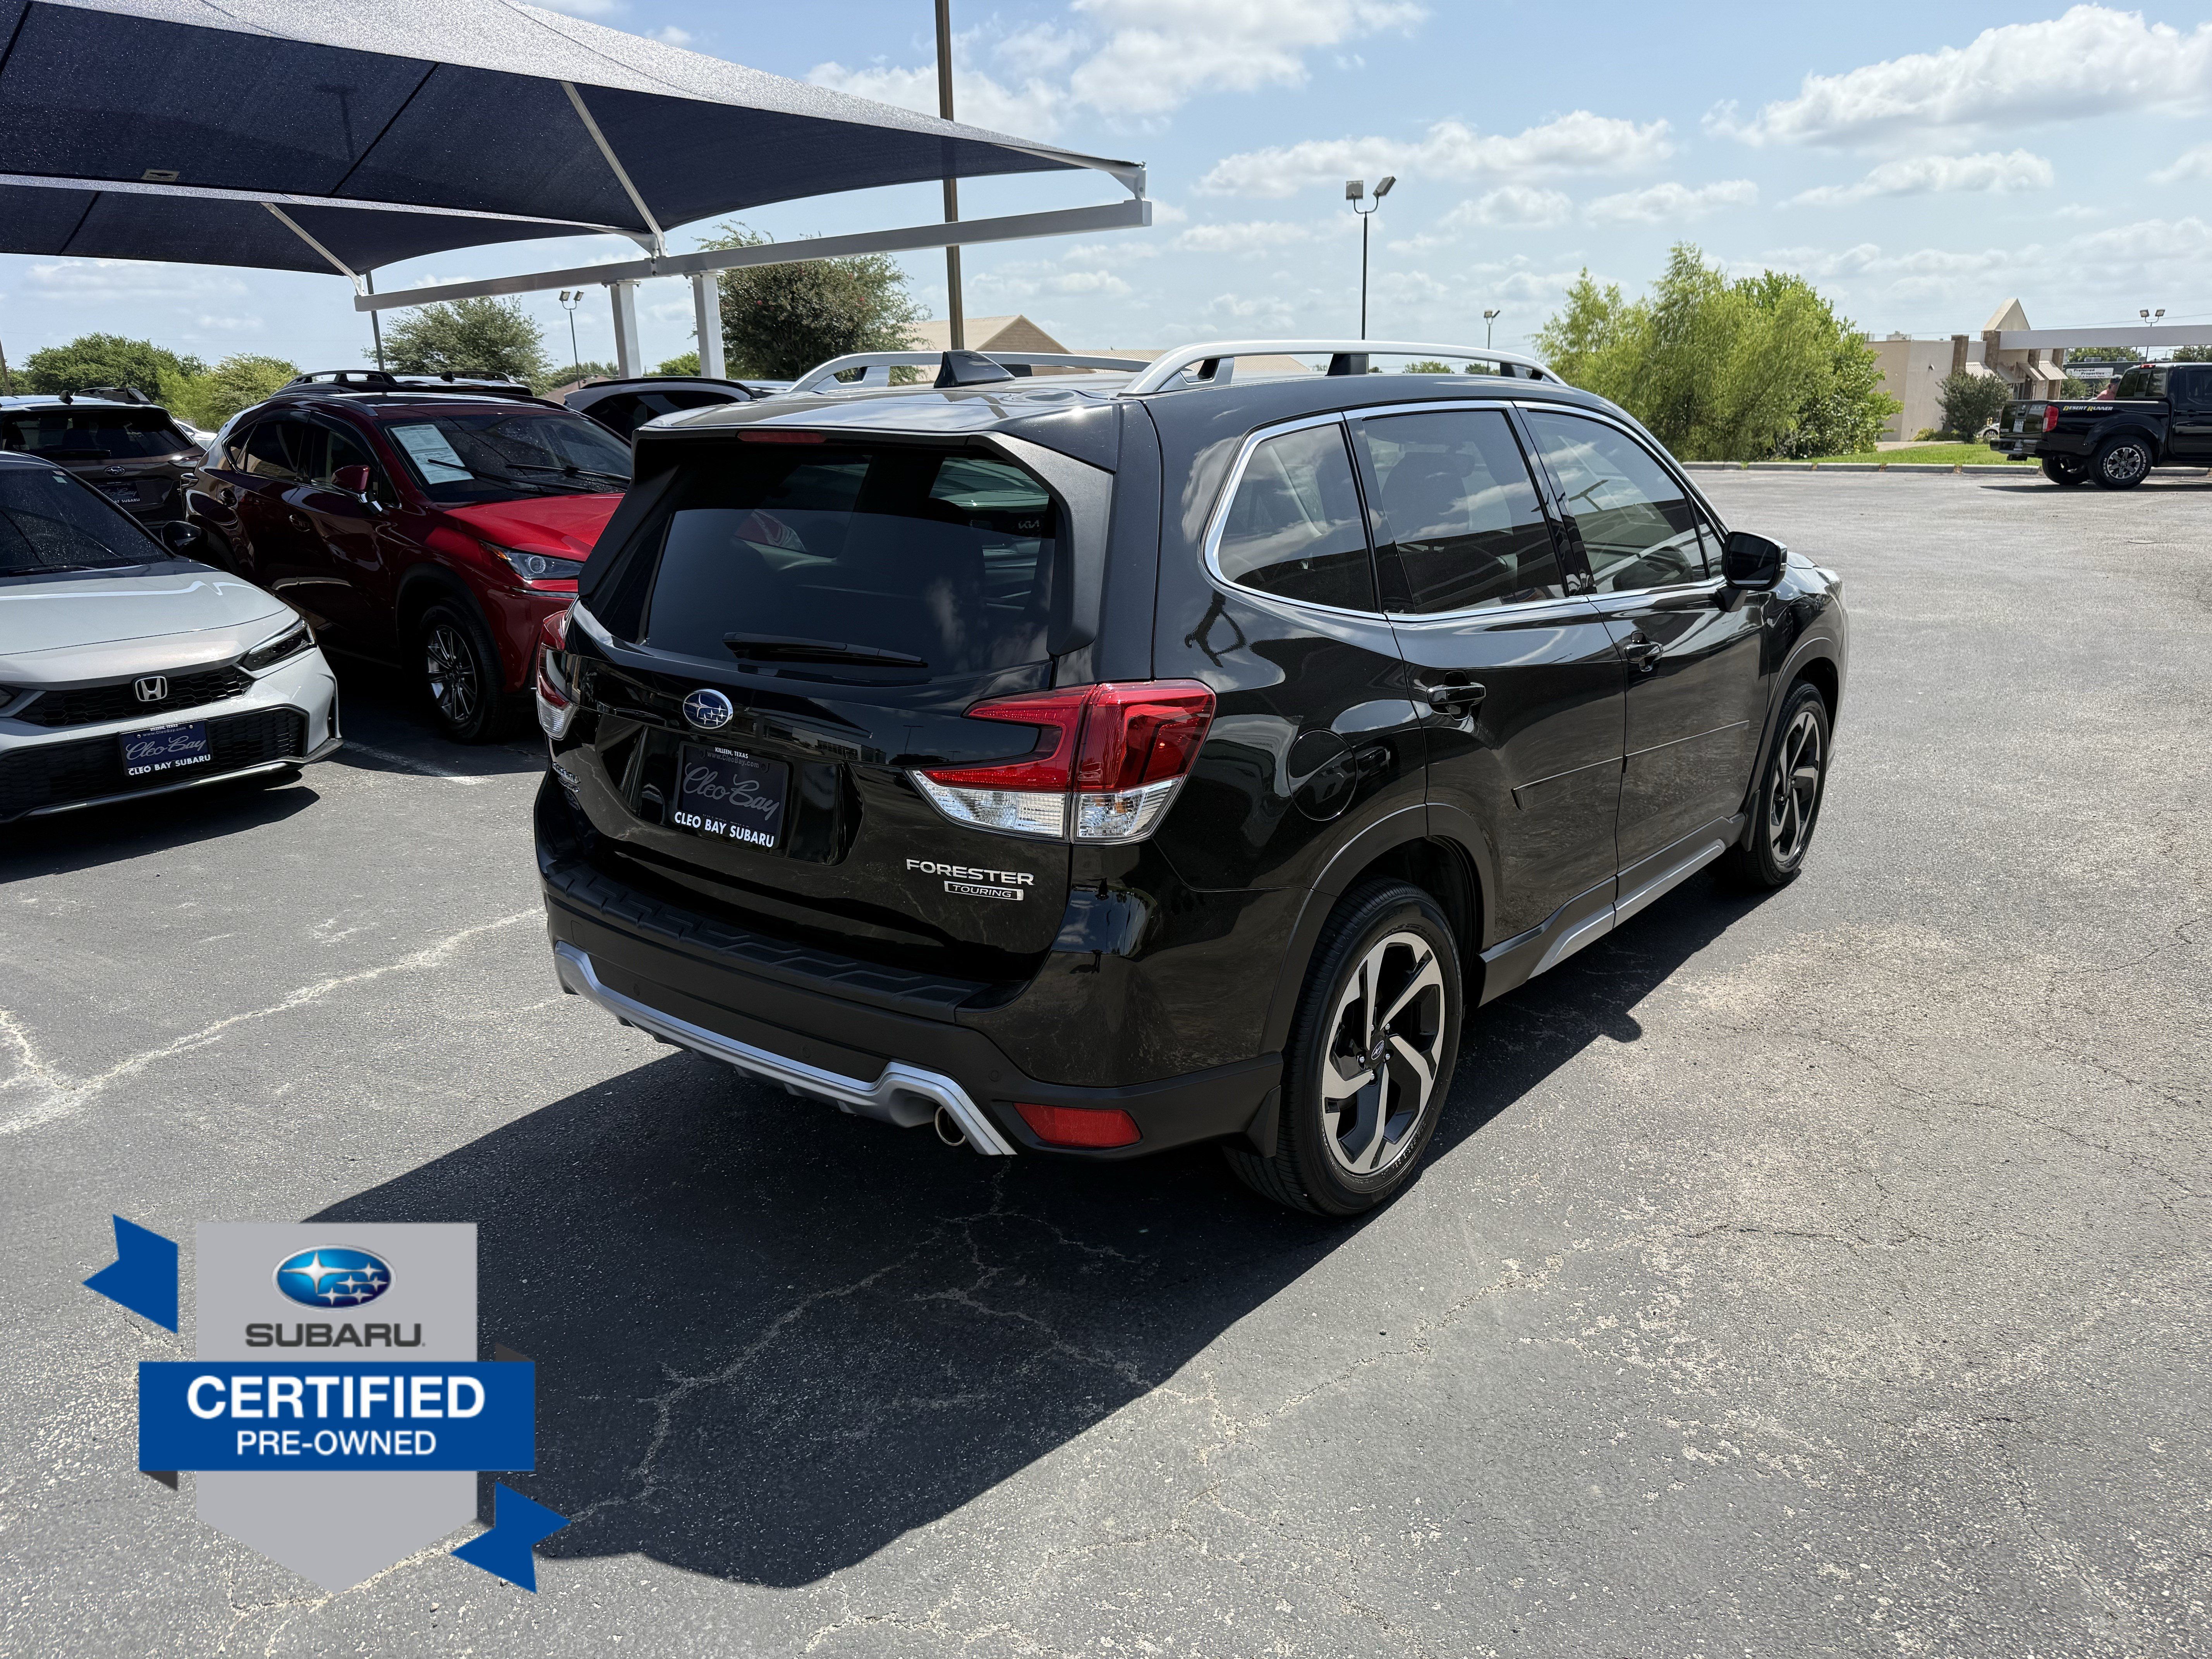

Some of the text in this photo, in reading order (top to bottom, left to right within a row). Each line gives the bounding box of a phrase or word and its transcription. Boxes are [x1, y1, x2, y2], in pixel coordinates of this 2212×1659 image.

[125, 736, 206, 760] Cleo Bay
[715, 747, 733, 756] KILLEEN,
[129, 754, 211, 775] CLEO BAY SUBARU
[707, 751, 759, 768] www.CleoBay.com
[683, 762, 780, 821] Cleo Bay
[675, 811, 701, 828] CLEO
[704, 819, 727, 834] BAY
[729, 825, 775, 847] SUBARU
[906, 859, 1035, 886] FORESTER
[952, 884, 1012, 898] TOURING
